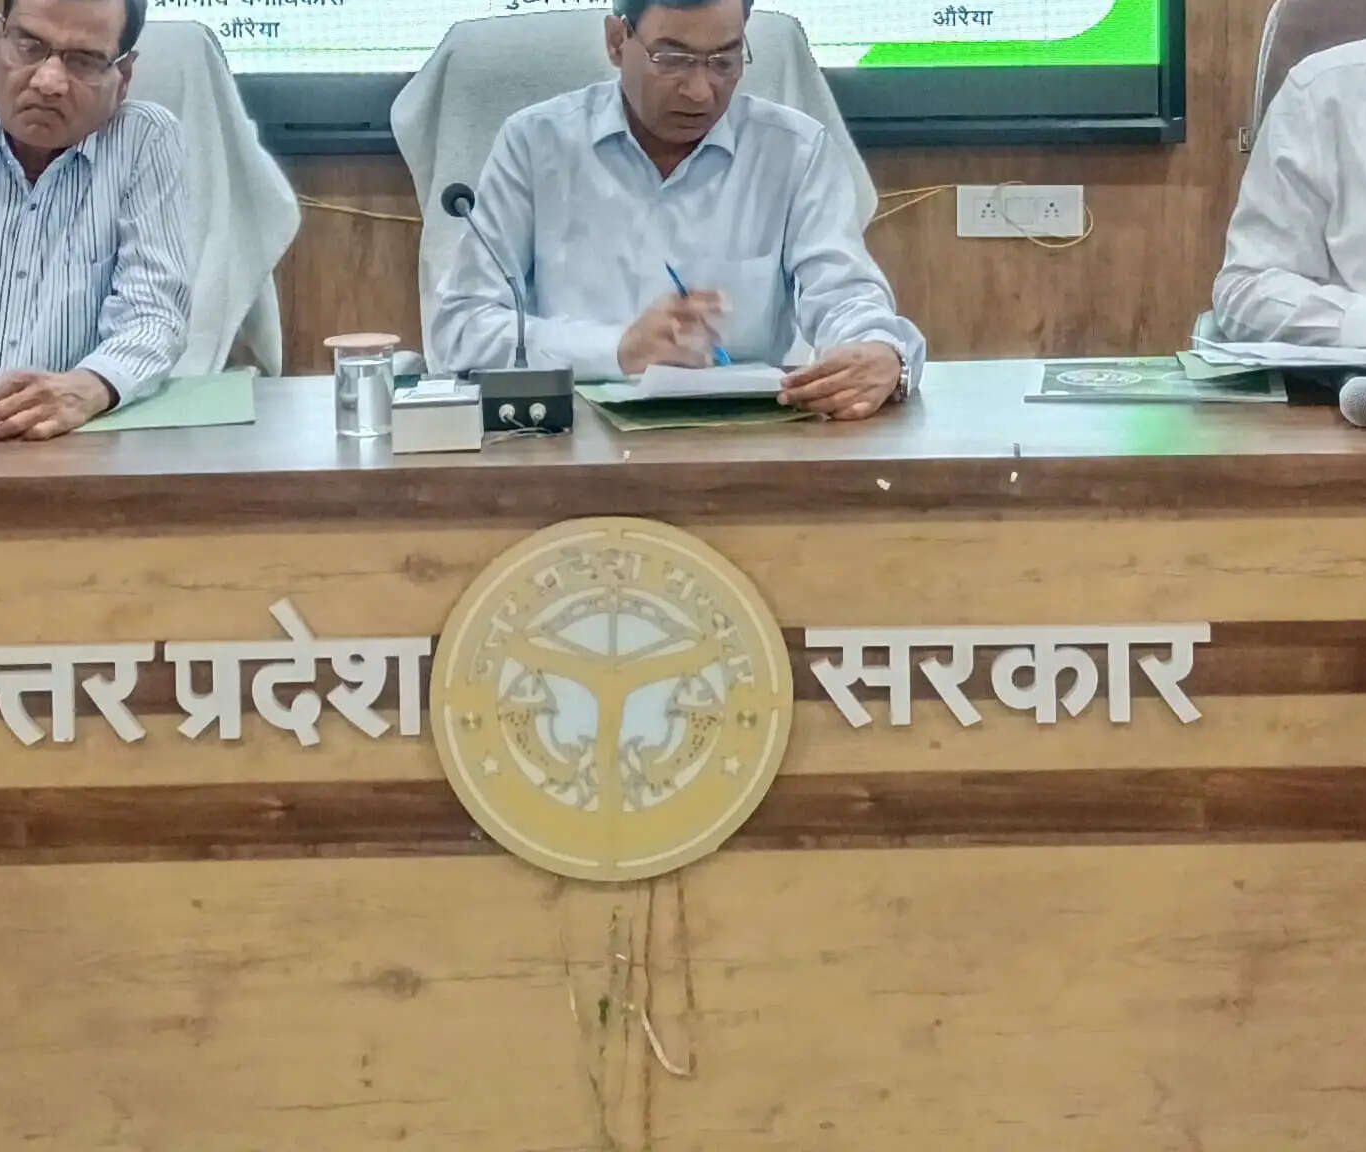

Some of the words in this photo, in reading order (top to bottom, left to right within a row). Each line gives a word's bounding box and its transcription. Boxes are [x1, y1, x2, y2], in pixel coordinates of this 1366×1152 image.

[932, 4, 994, 27] औरैया
[218, 16, 281, 39] औरैया
[164, 597, 432, 747] प्रदेश
[806, 621, 1212, 728] सरकार
